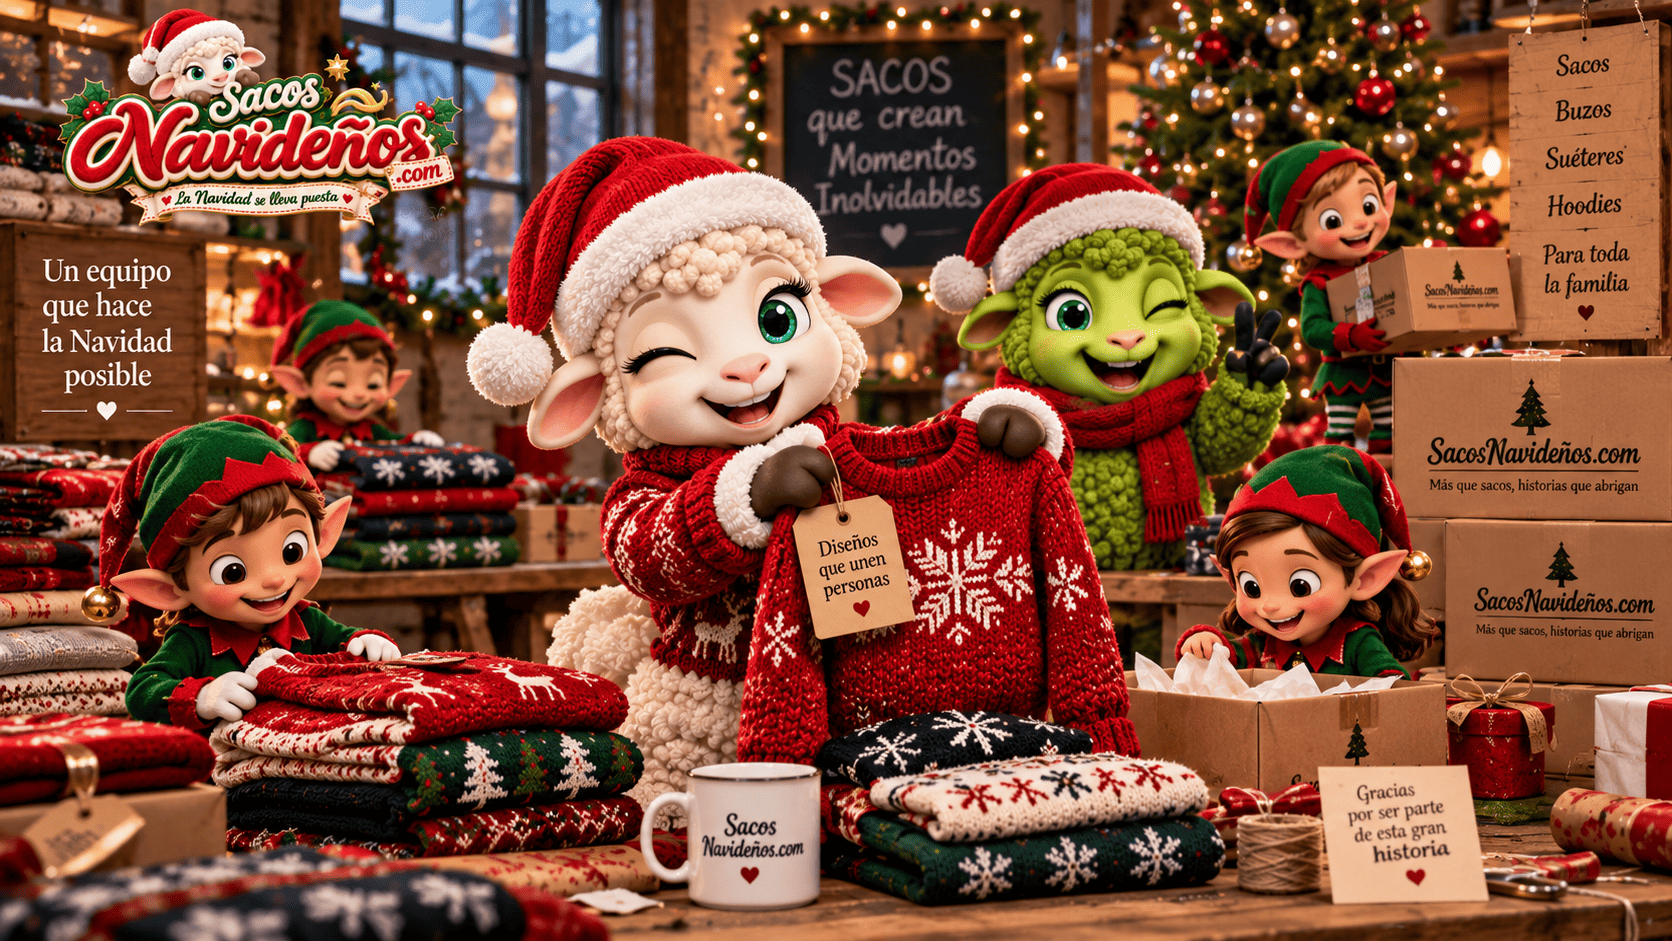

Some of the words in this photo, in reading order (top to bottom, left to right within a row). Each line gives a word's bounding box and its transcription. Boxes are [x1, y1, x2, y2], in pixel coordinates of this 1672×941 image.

[830, 56, 952, 98] SACOS
[1556, 54, 1610, 76] Sacos
[1555, 100, 1612, 122] Buzos
[806, 108, 864, 147] que
[878, 104, 968, 130] crean
[828, 136, 976, 178] Momentos
[1545, 146, 1624, 170] Suéteres
[814, 174, 982, 216] Inolvidables
[1548, 192, 1622, 217] Hoodies
[1542, 244, 1585, 265] Para
[1590, 240, 1630, 262] toda
[42, 258, 80, 282] Un
[86, 258, 172, 289] equipo
[1544, 273, 1561, 293] la
[1565, 271, 1630, 299] familia
[42, 300, 89, 324] que
[96, 291, 152, 316] hace
[42, 328, 64, 352] la
[70, 328, 172, 352] Navidad
[64, 361, 152, 394] posible
[1428, 437, 1641, 466] SacosNavideños.com
[1430, 478, 1454, 491] Más
[1456, 482, 1477, 494] que
[1481, 482, 1514, 494] sacos,
[1518, 478, 1567, 492] historias
[1570, 482, 1592, 494] que
[1594, 479, 1639, 495] abrigan
[818, 534, 879, 558] Diseños
[819, 562, 846, 580] que
[850, 554, 886, 572] unen
[824, 574, 890, 602] personas
[1474, 588, 1656, 614] SacosNavideños.com
[1476, 624, 1496, 635] Más
[1498, 626, 1516, 638] que
[1519, 626, 1548, 638] sacos,
[1550, 625, 1592, 638] historias
[1595, 628, 1613, 640] que
[1616, 627, 1654, 642] abrigan
[1356, 783, 1416, 805] Gracias
[724, 812, 777, 837] Sacos
[1348, 810, 1374, 827] por
[1378, 807, 1400, 820] ser
[1404, 800, 1445, 821] parte
[1354, 827, 1372, 842] de
[1377, 824, 1407, 840] esta
[1412, 823, 1447, 840] gran
[702, 835, 804, 858] Navideños.com
[1373, 840, 1450, 863] historia
